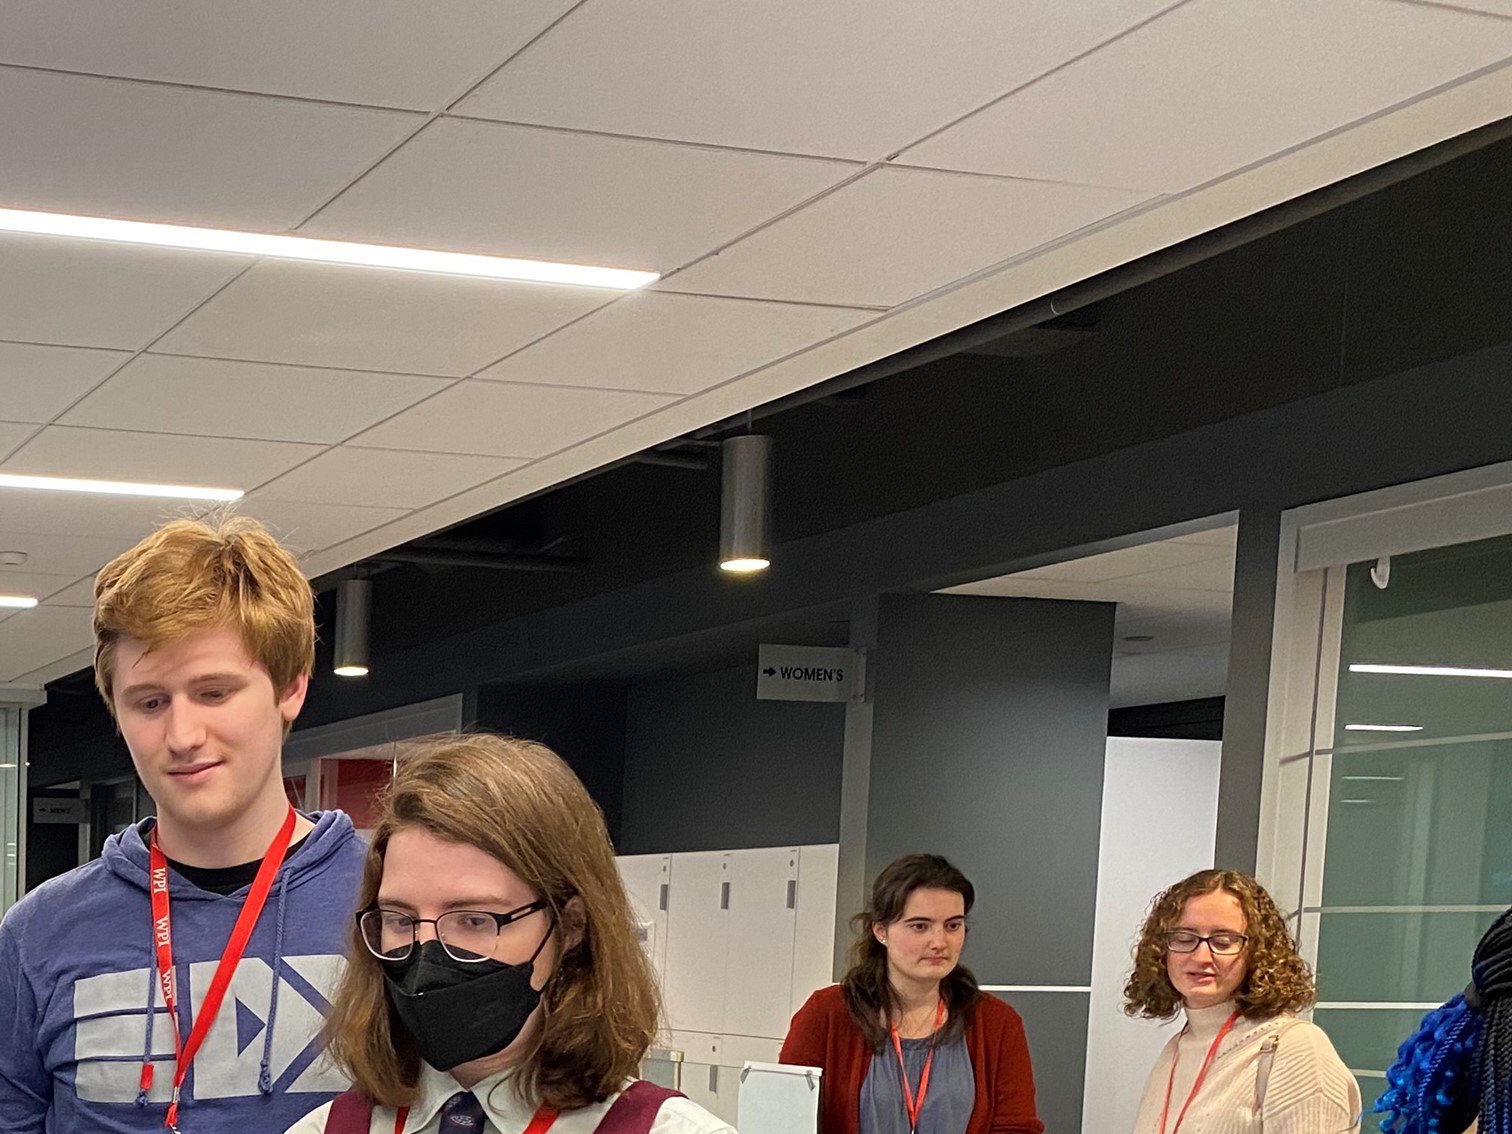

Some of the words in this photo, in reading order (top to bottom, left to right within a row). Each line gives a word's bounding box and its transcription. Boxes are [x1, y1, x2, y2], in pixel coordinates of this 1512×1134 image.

[780, 667, 844, 682] WOMEN'S
[153, 867, 167, 894] WPI
[156, 915, 171, 947] WPI
[162, 969, 173, 1000] WPI
